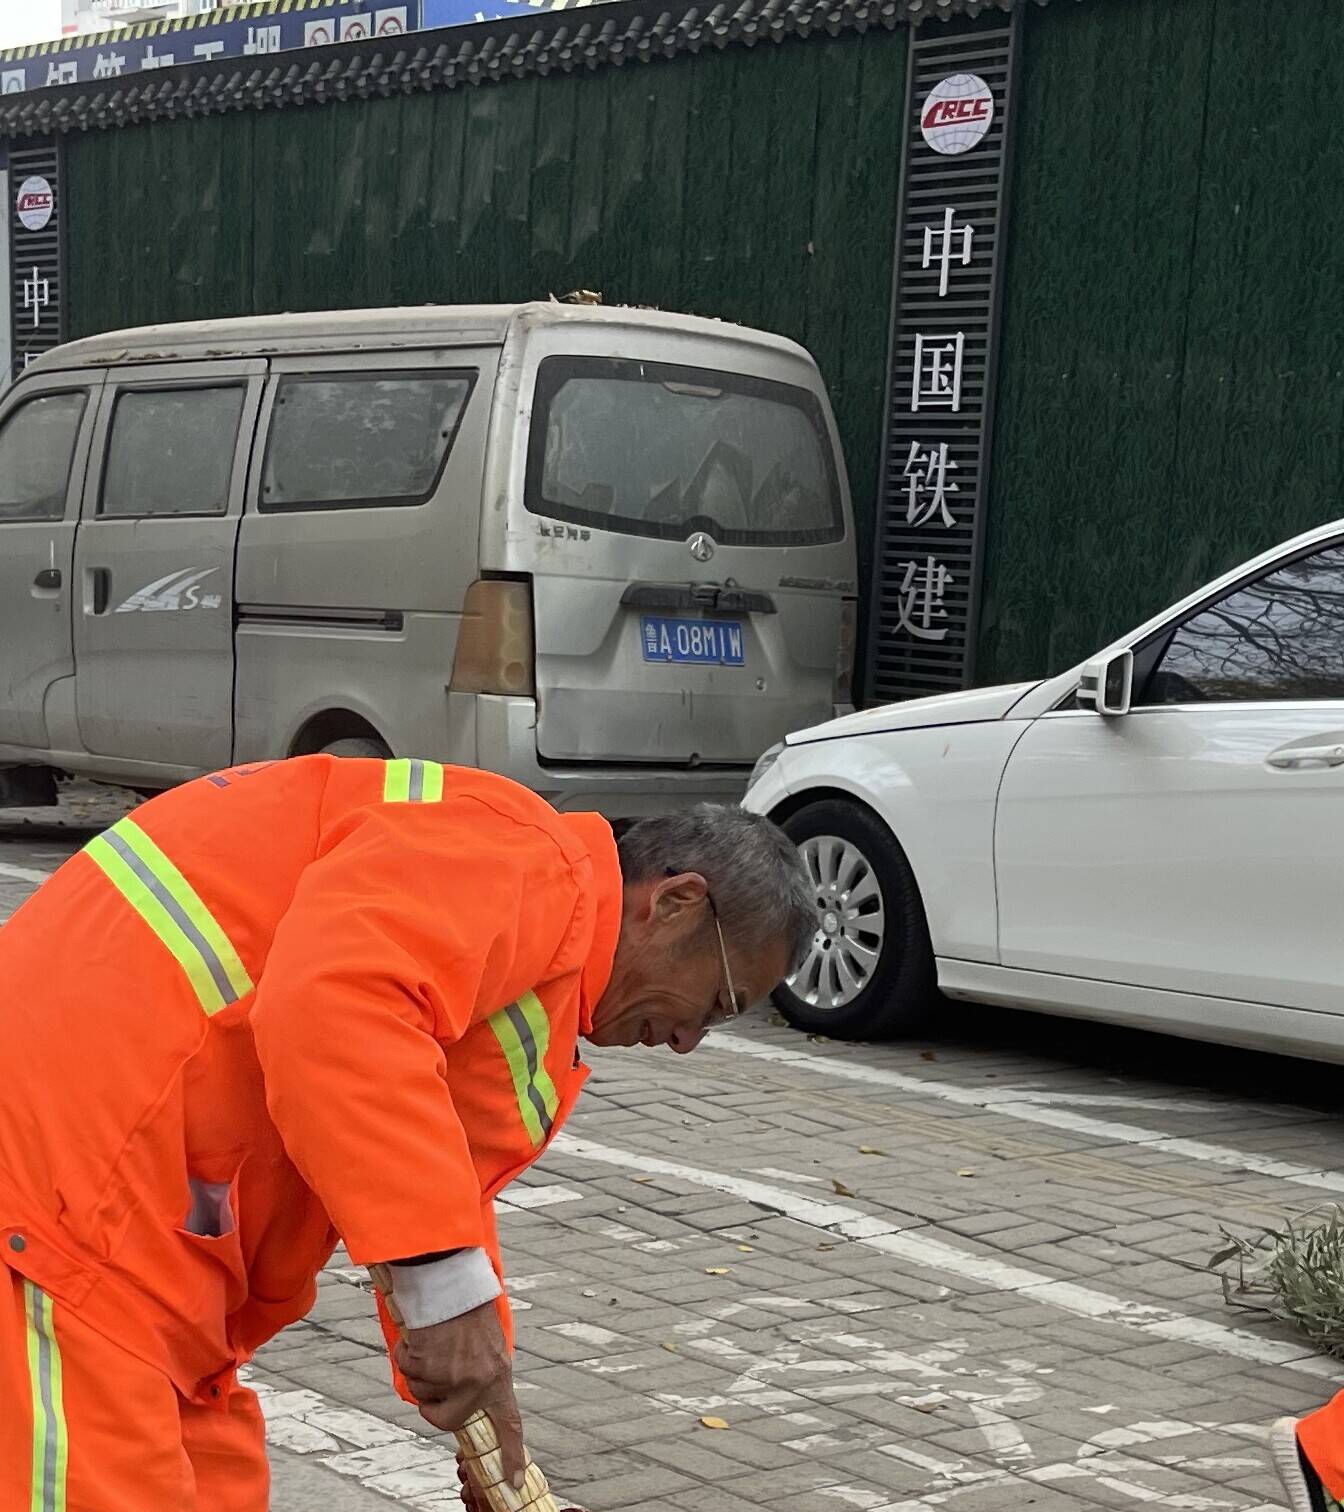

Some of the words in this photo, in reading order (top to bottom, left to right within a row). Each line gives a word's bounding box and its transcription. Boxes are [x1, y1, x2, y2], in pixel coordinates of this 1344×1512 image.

[922, 98, 992, 129] CRCC
[892, 207, 974, 642] 中国铁建
